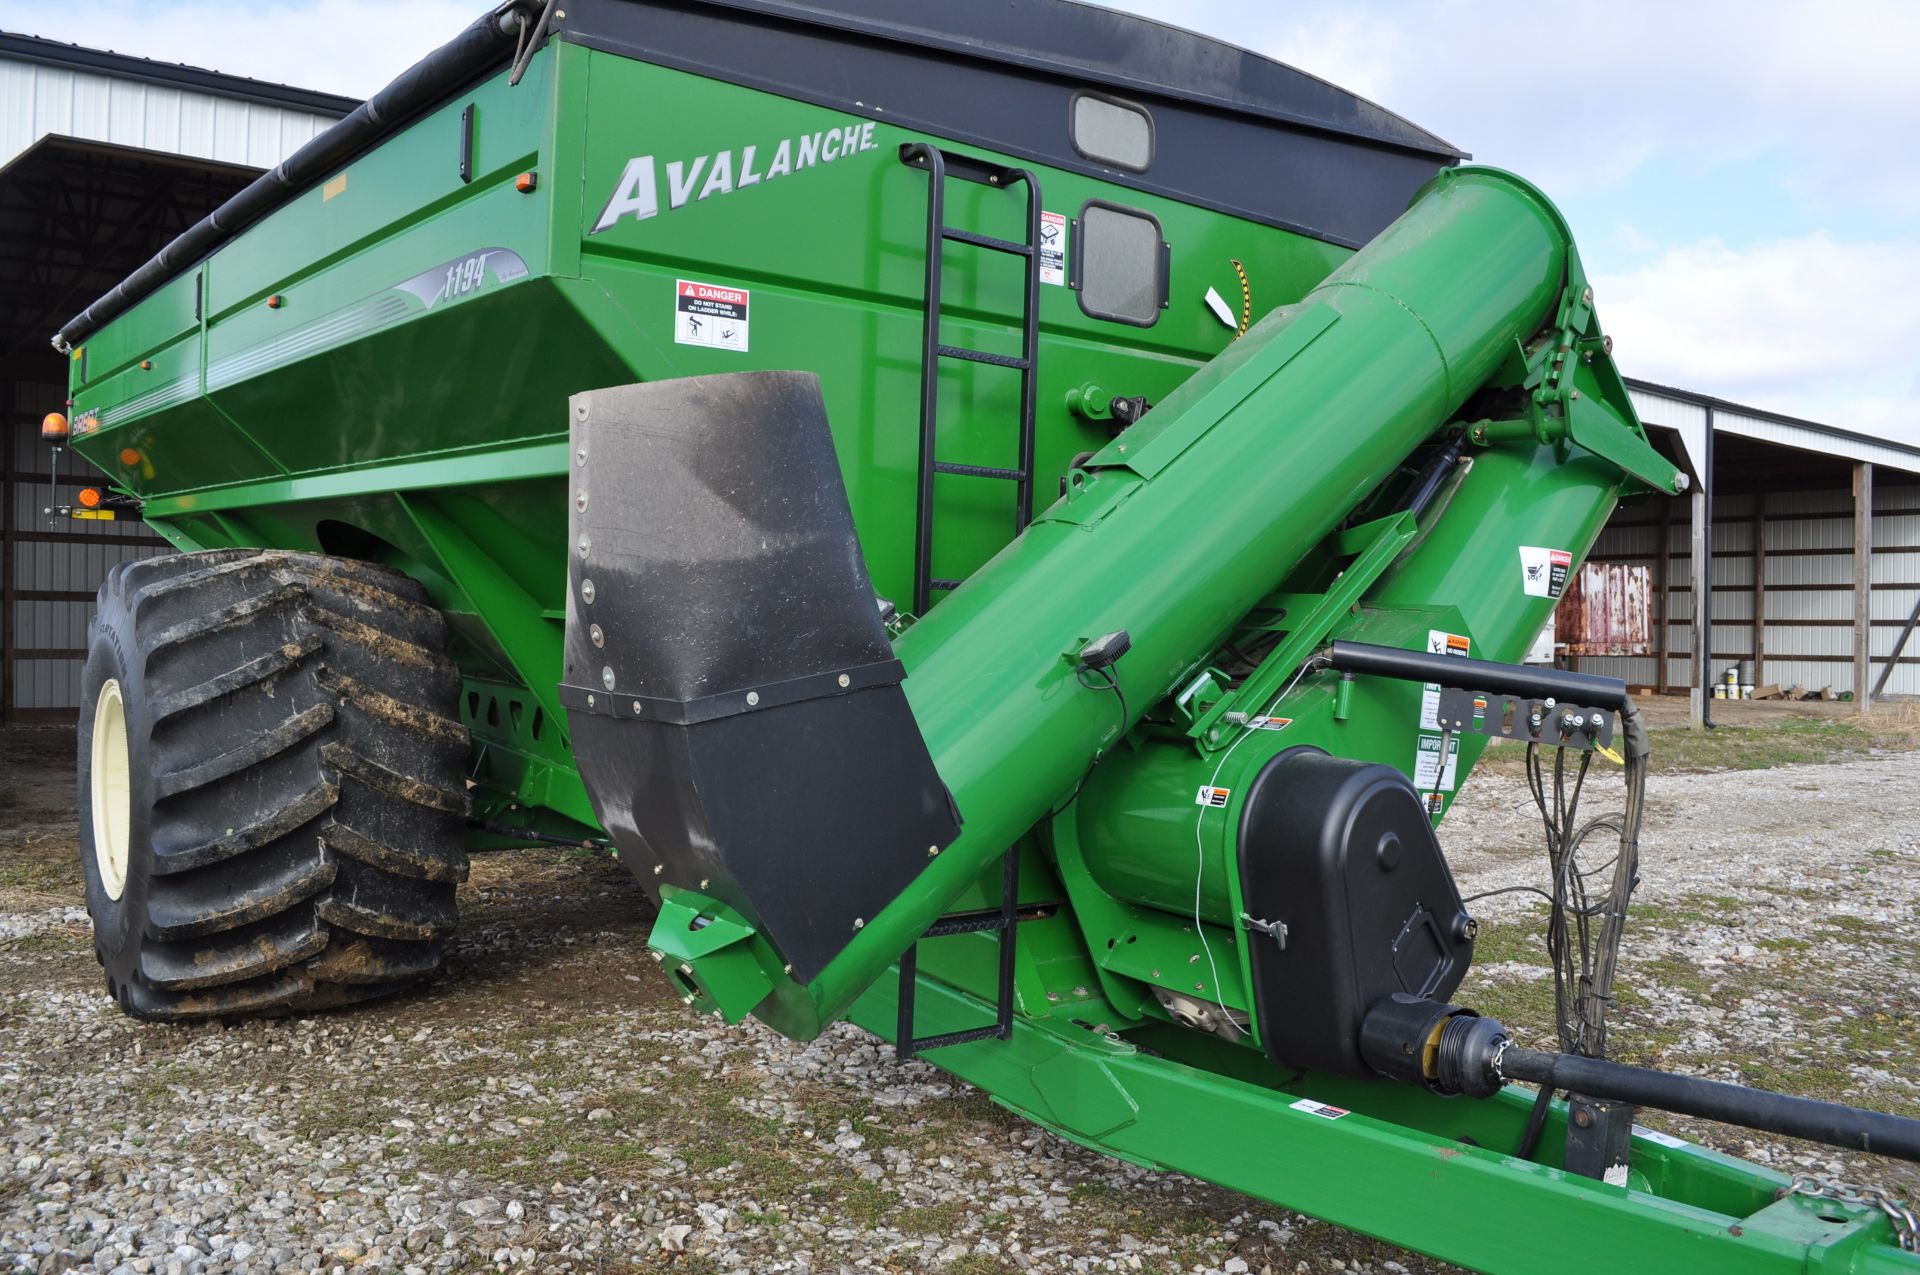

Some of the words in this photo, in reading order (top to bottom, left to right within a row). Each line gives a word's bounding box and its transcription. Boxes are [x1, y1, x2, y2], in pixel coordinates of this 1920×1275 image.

[588, 122, 876, 235] AVALANCHE
[444, 253, 487, 300] 1194
[699, 287, 742, 302] DANGER
[697, 306, 719, 314] LADDER
[703, 300, 715, 308] NOT
[715, 302, 733, 310] STAND
[1420, 738, 1456, 752] IMPORT
